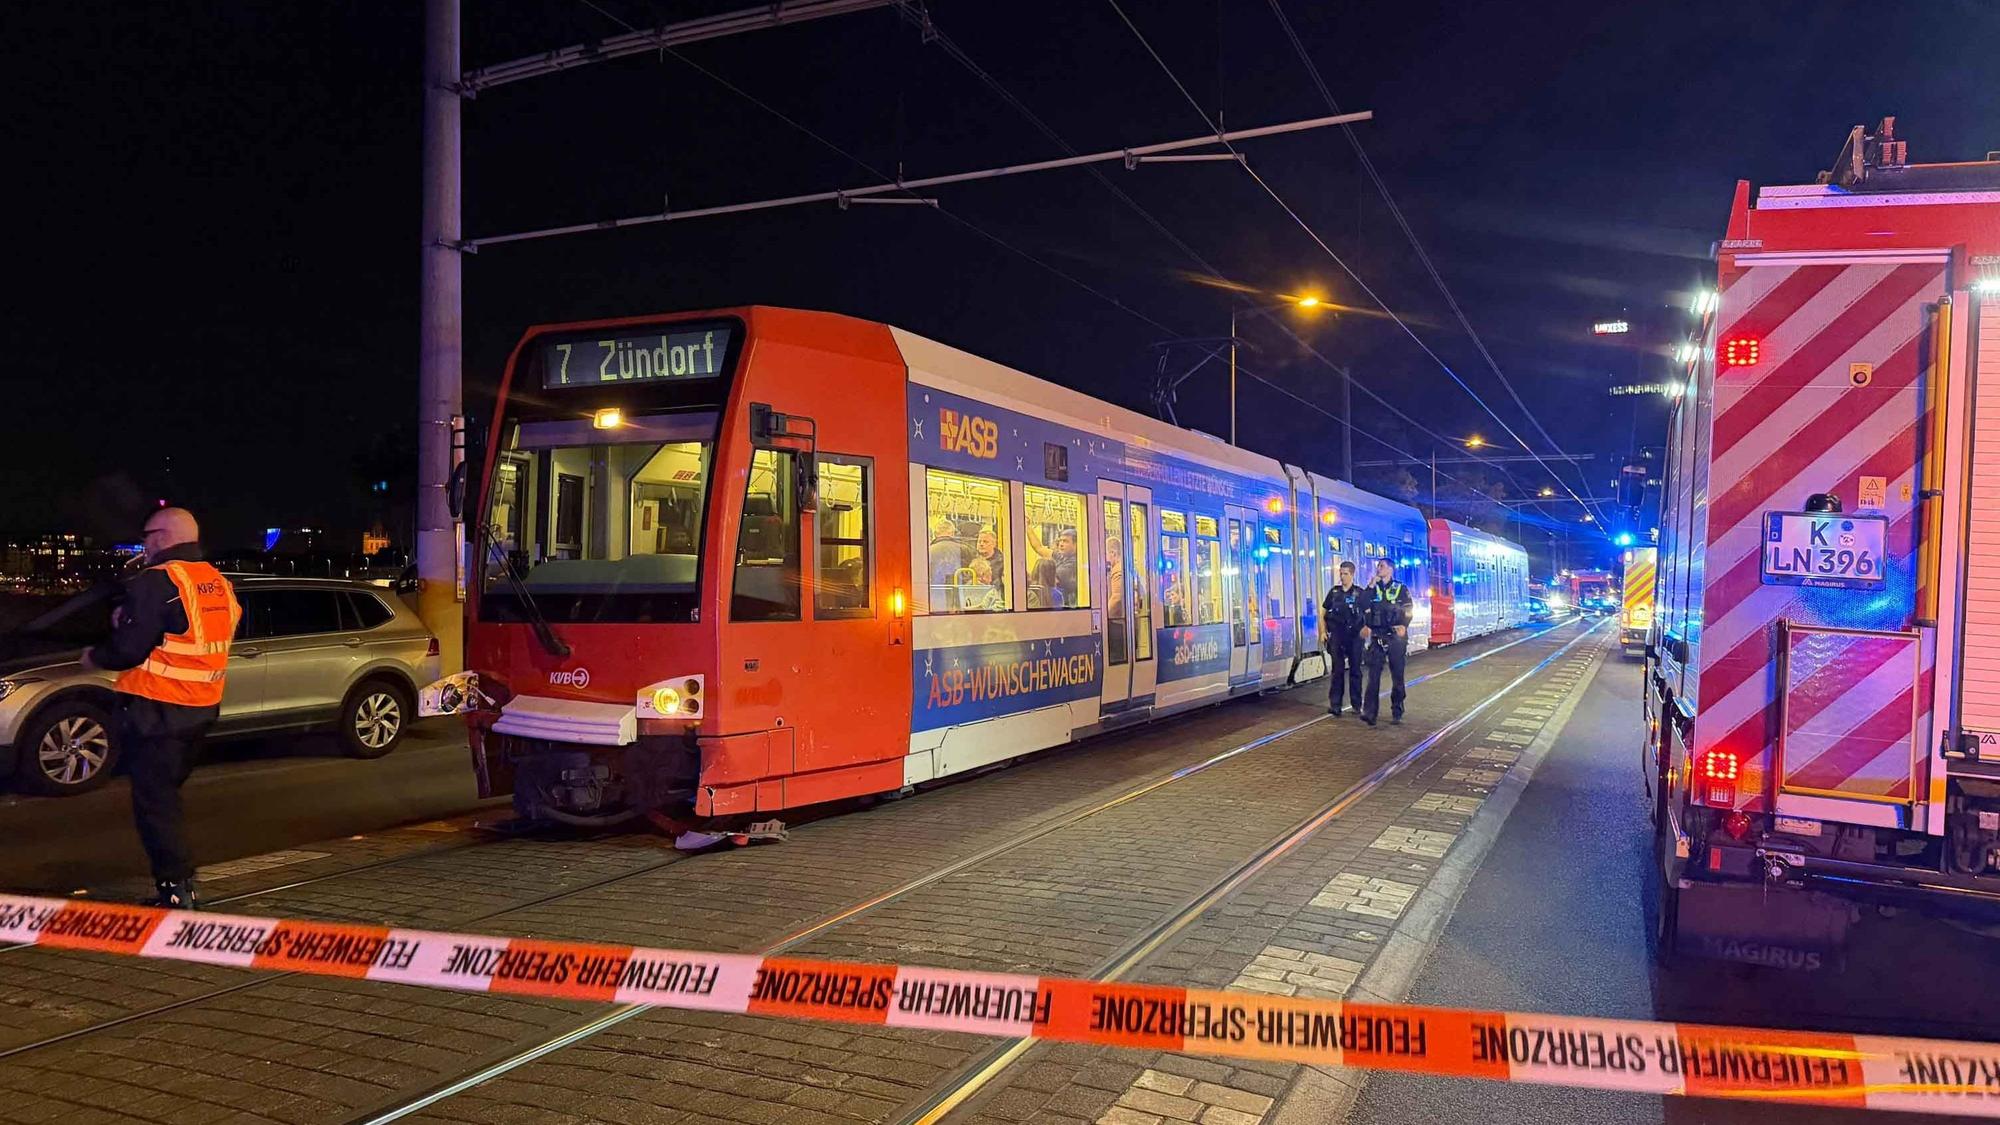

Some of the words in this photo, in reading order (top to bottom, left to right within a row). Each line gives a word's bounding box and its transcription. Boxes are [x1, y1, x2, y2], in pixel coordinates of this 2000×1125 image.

[556, 343, 572, 384] 7
[598, 331, 713, 381] Zündorf
[955, 414, 999, 460] ASB
[1810, 521, 1829, 546] K
[1773, 547, 1811, 572] LN
[1818, 550, 1873, 575] 396
[1814, 580, 1845, 588] MAGIRUS
[550, 672, 572, 684] KVB
[927, 653, 1095, 710] ASB-WÜNSCHEWAGEN
[166, 920, 420, 969] FEUERWEHR-SPERRZONE
[1703, 936, 1821, 970] MAGIRUS
[442, 944, 720, 995] FEUERWEHR-SPERRZONE
[748, 969, 1053, 1025] FEUERWEHR-SPERRZONE
[1090, 994, 1426, 1057] FEUERWEHR-SPERRZONE
[1472, 1022, 1849, 1087] FEUERWEHR-SPERRZONE
